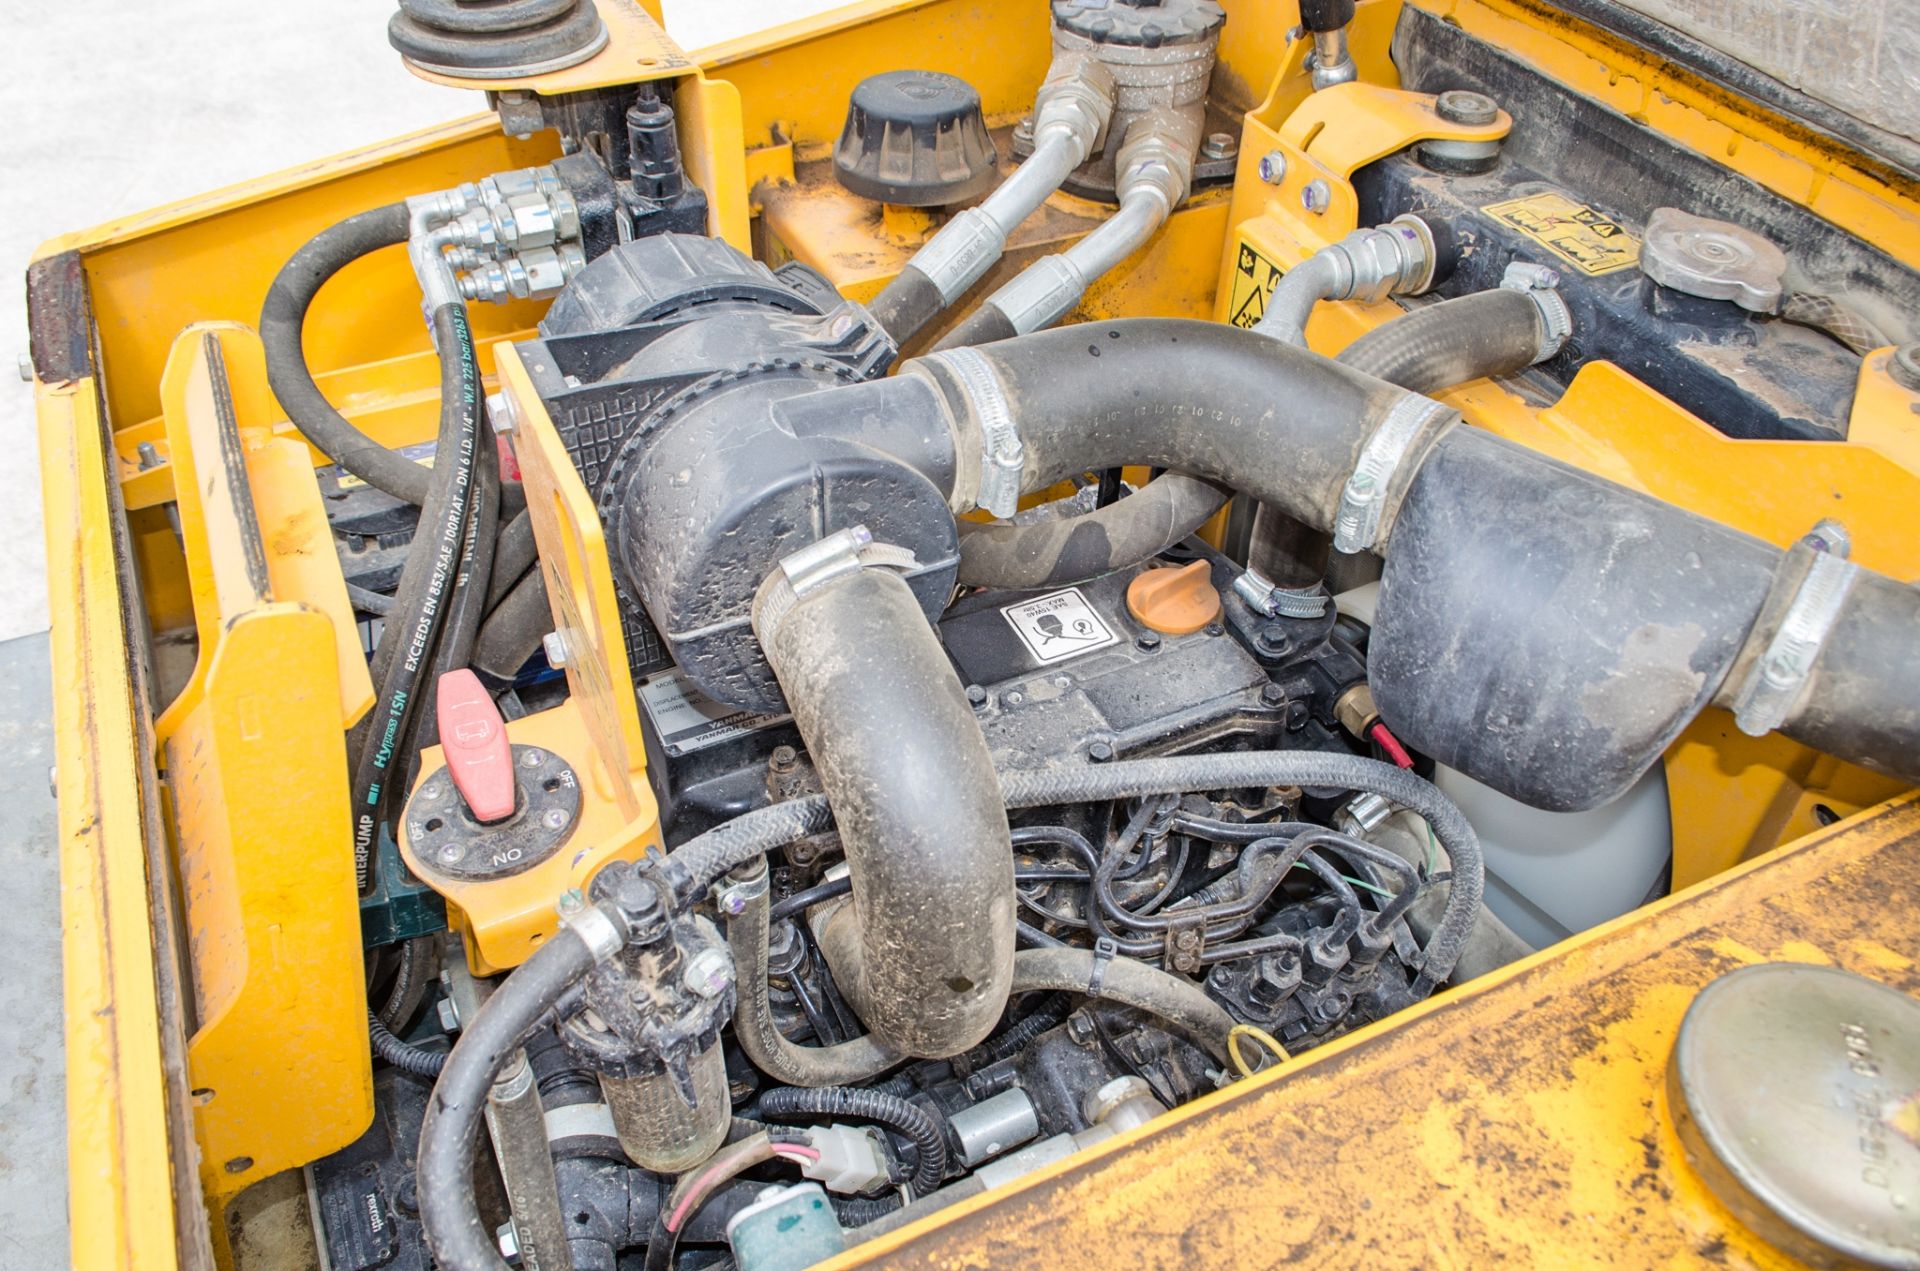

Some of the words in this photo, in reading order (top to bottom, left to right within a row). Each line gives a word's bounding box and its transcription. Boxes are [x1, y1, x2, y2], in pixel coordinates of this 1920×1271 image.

[454, 319, 472, 361] bar/3263
[462, 362, 474, 380] 225
[464, 384, 475, 403] W.P.
[462, 412, 474, 433] 1/4"
[460, 438, 473, 456] I.D.
[456, 466, 470, 486] DN
[444, 494, 464, 542] 100R1AT
[429, 545, 453, 595] 853/SAE
[423, 597, 438, 616] EN
[404, 617, 432, 672] EXCEEDS
[655, 678, 685, 689] MODEL
[390, 690, 407, 716] 1SN
[657, 703, 688, 716] ENGINE
[695, 724, 740, 742] YANMAR
[374, 718, 398, 769] Hypress
[559, 769, 576, 788] OFF
[409, 821, 425, 841] OFF
[493, 848, 522, 866] ON
[756, 1009, 769, 1029] SAE
[760, 1030, 779, 1054] HOSE
[366, 1193, 384, 1233] rexroth
